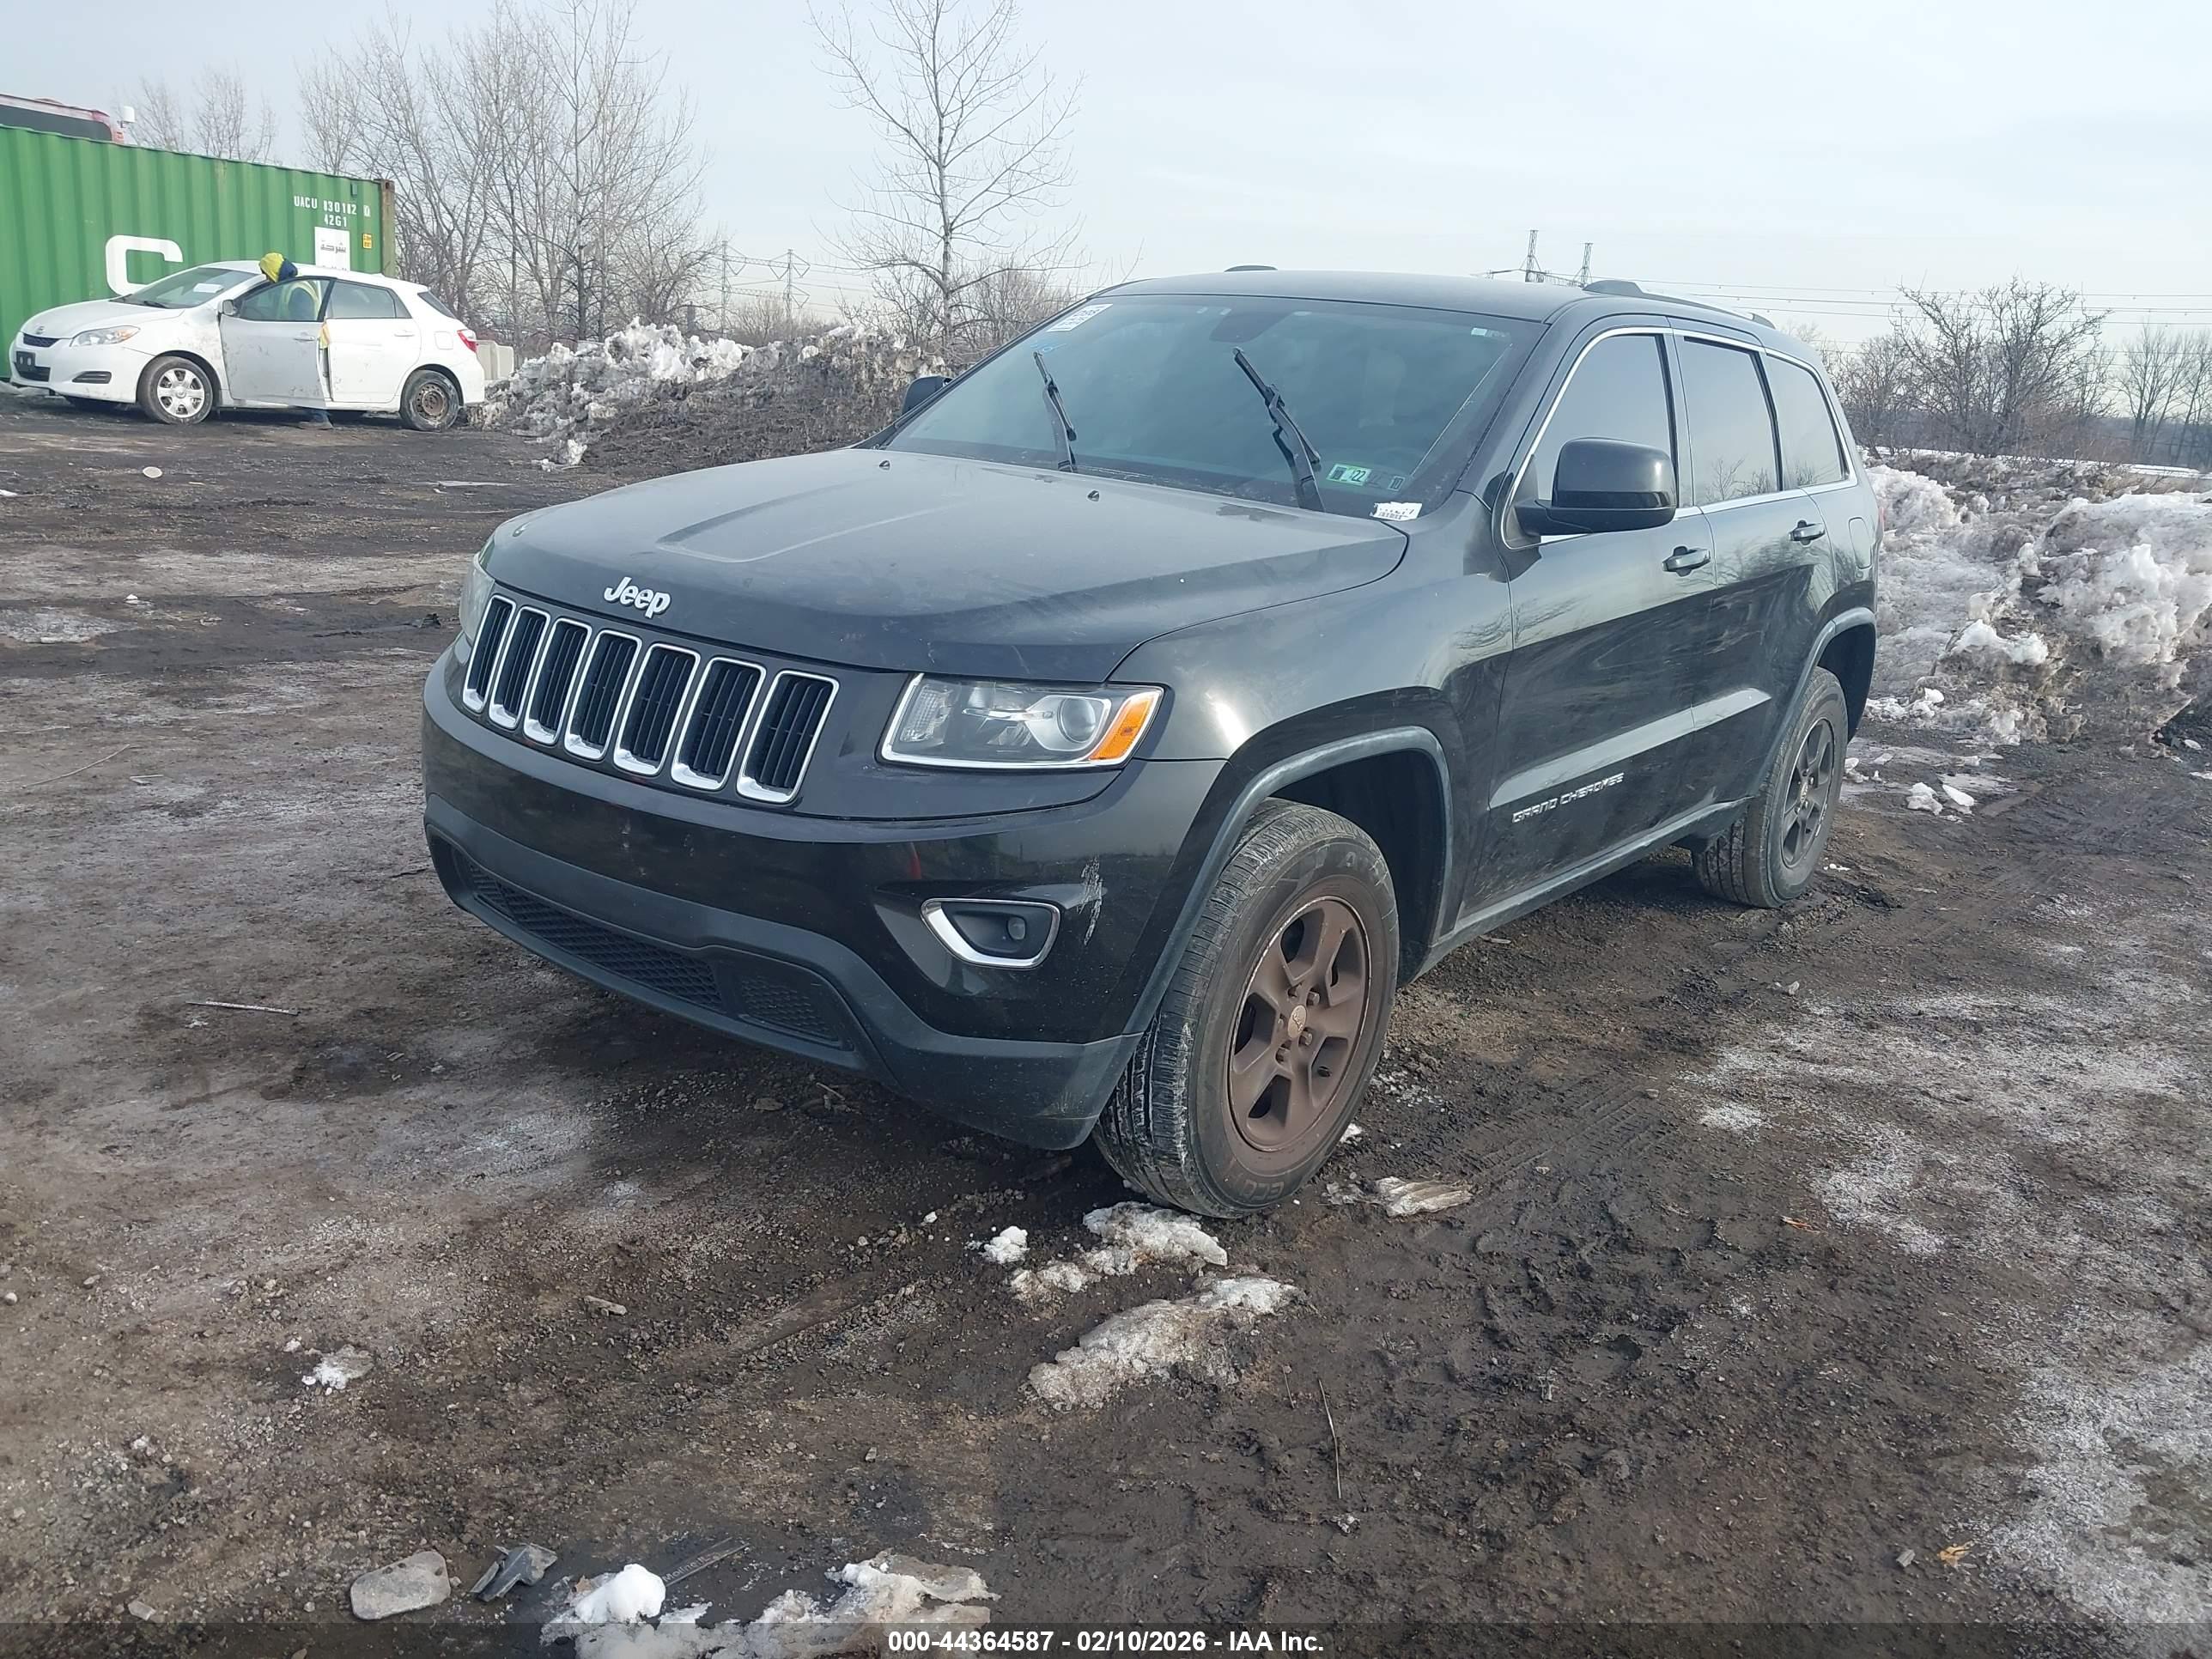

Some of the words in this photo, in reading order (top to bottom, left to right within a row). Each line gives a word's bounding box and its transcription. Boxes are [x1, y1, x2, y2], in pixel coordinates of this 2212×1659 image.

[294, 196, 318, 210] UACU
[324, 214, 347, 228] 42G1
[604, 576, 671, 619] Jeep
[1512, 797, 1559, 823] GRAND
[1559, 772, 1625, 805] CHEROKEE
